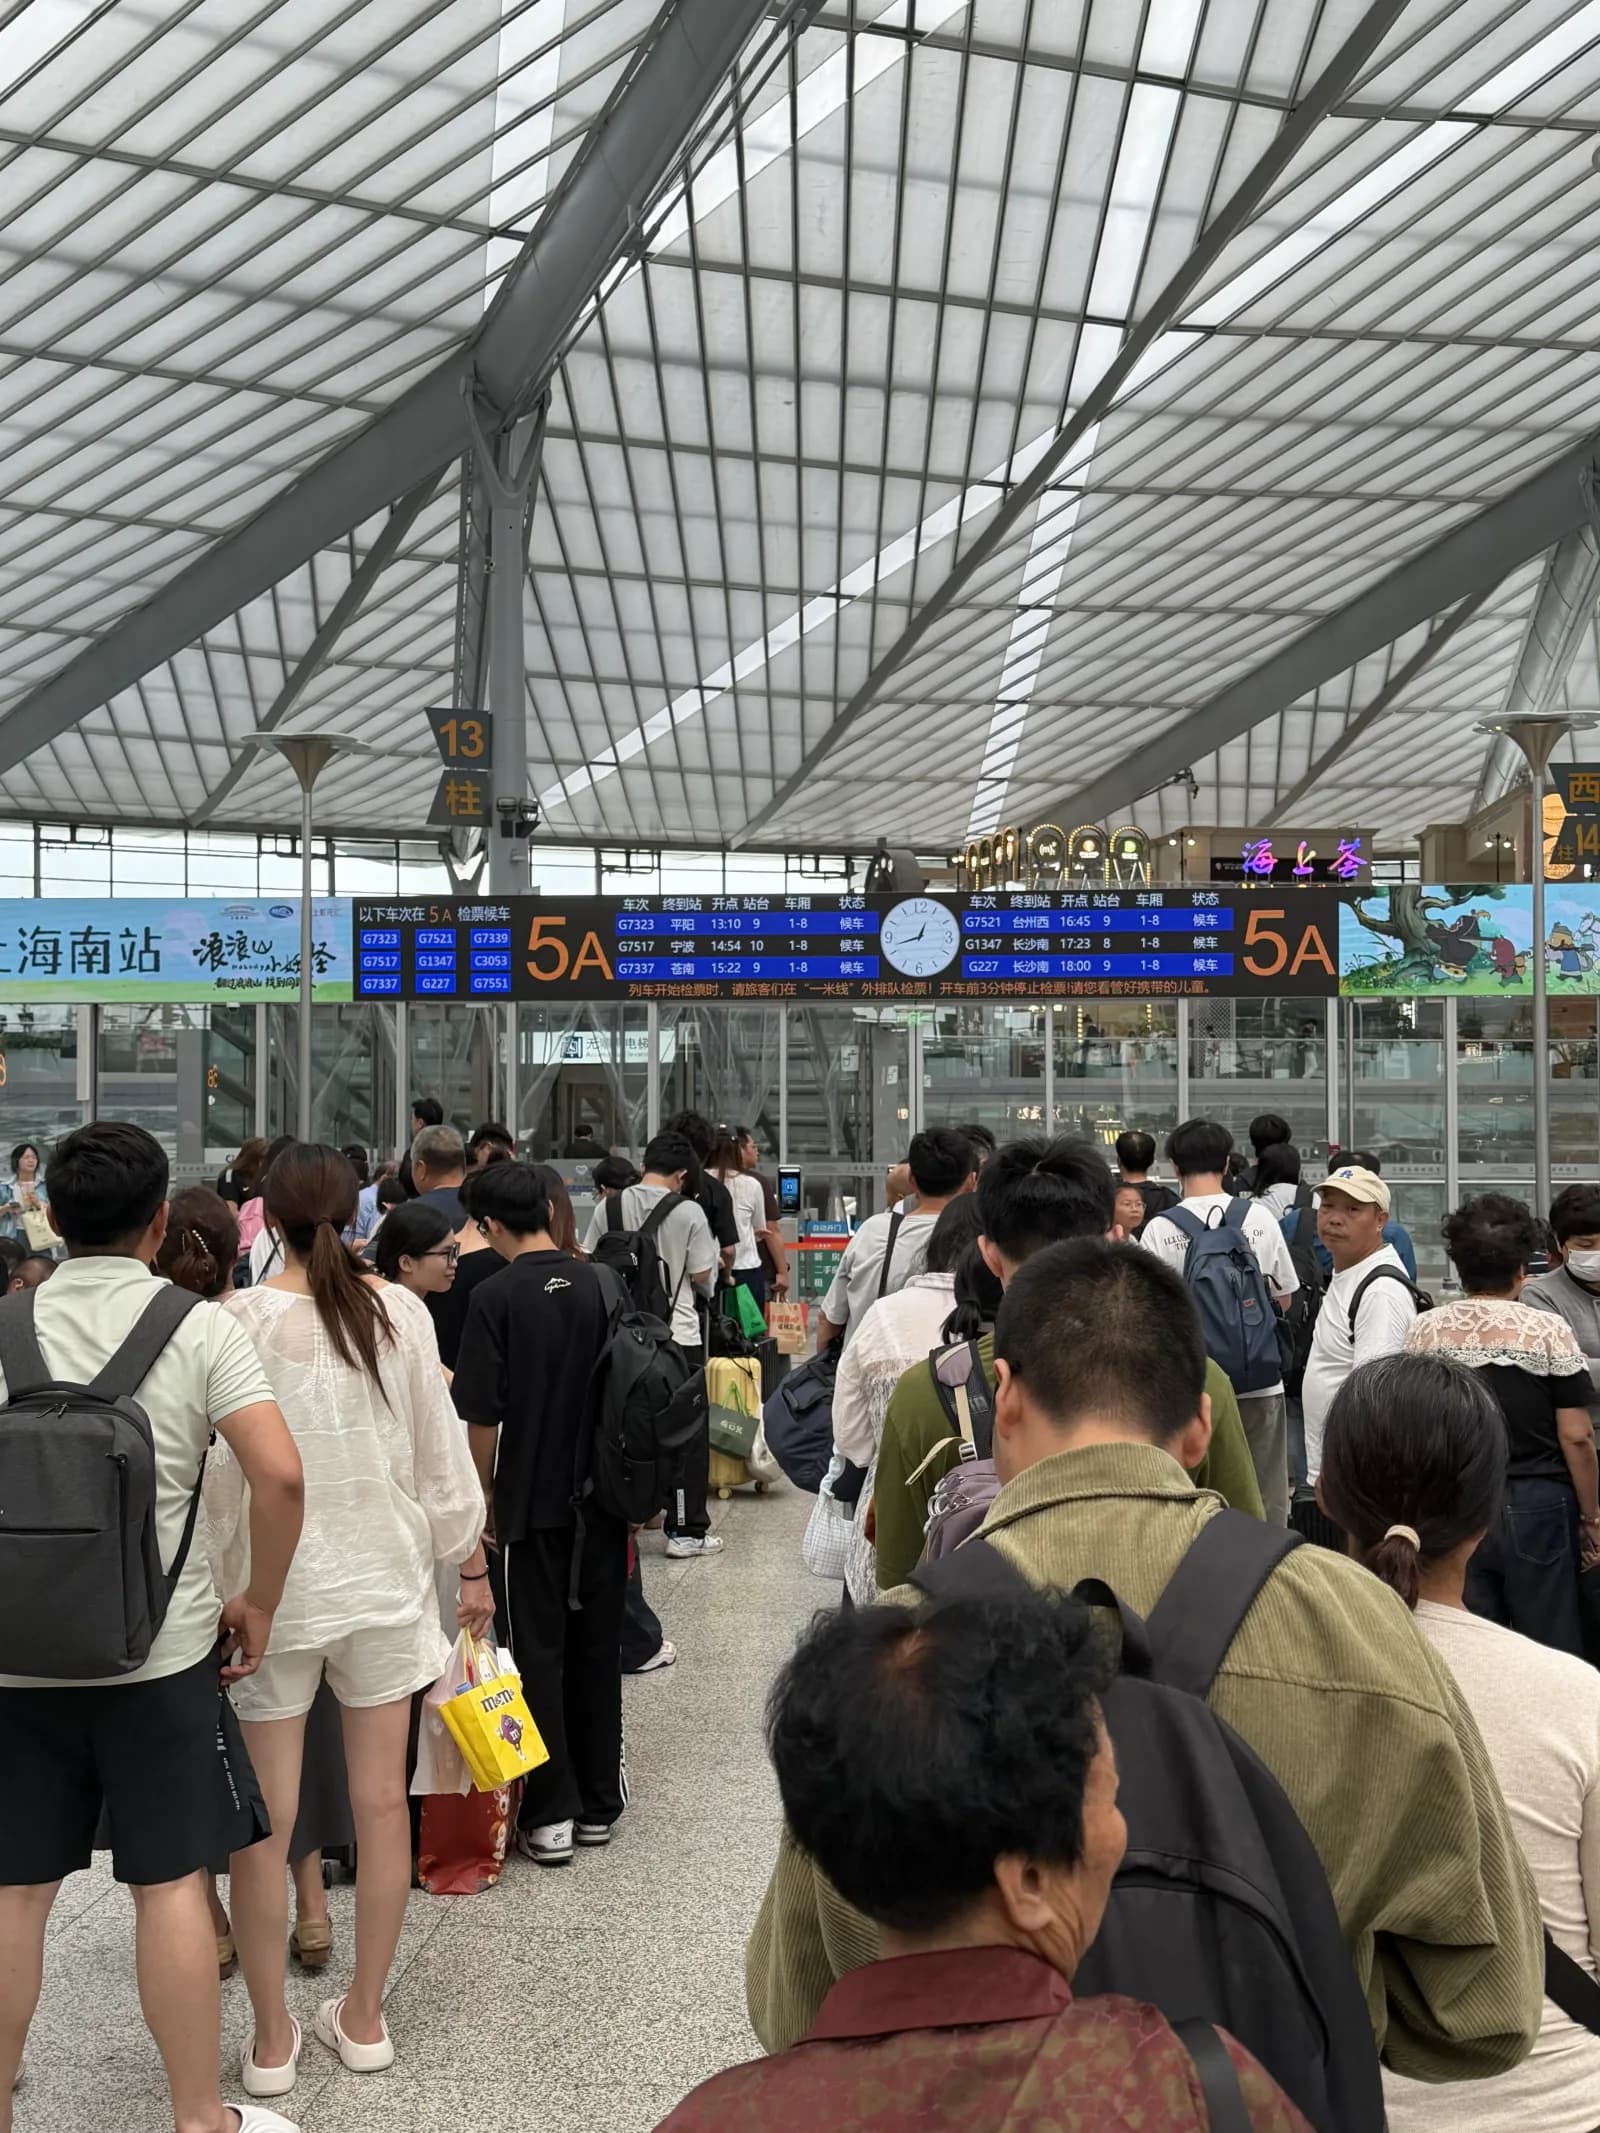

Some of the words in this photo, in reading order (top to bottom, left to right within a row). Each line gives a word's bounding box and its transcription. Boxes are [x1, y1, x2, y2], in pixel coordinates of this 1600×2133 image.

[439, 719, 485, 758] 13
[1567, 772, 1600, 804] 西
[446, 780, 481, 816] 柱
[1575, 822, 1600, 857] 14
[623, 897, 649, 912] 车次
[662, 896, 703, 911] 终到站
[711, 896, 739, 911] 开点
[743, 896, 770, 911] 站台
[784, 896, 811, 910] 车厢
[838, 895, 865, 910] 状态
[912, 901, 930, 914] 12
[969, 894, 997, 909] 车次
[1010, 894, 1051, 909] 终到站
[1060, 893, 1089, 908] 开点
[1092, 892, 1121, 908] 站台
[1135, 892, 1163, 907] 车厢
[1191, 891, 1220, 906] 状态
[359, 906, 426, 923] 以下车次在
[457, 905, 511, 922] 检票候车
[964, 916, 1001, 928] G7521
[1012, 915, 1049, 929] 台州西
[1060, 915, 1091, 927] 16:45
[1103, 915, 1111, 927] 9
[1140, 914, 1160, 926] 1-8
[1192, 913, 1218, 927] 候车
[618, 919, 655, 930] G7323
[670, 918, 695, 931] 平阳
[711, 918, 742, 930] 13:10
[752, 918, 761, 929] 9
[789, 917, 808, 929] 1-8
[839, 917, 864, 930] 候车
[363, 933, 398, 945] G7323
[418, 933, 453, 944] G7521
[473, 932, 509, 944] G7339
[884, 931, 893, 944] 9
[944, 931, 953, 944] 3
[964, 938, 1002, 950] G1347
[1012, 937, 1049, 951] 长沙南
[1060, 937, 1091, 949] 17:23
[1103, 937, 1111, 949] 8
[1140, 936, 1160, 949] 1-8
[1192, 935, 1218, 949] 候车
[1243, 909, 1335, 977] 5A
[0, 925, 163, 975] 海南站
[527, 916, 613, 981] 5A
[618, 940, 655, 953] G7517
[670, 940, 695, 954] 宁波
[711, 940, 741, 952] 14:54
[750, 940, 764, 951] 10
[789, 939, 808, 951] 1-8
[839, 939, 865, 952] 候车
[363, 956, 398, 967] G7517
[418, 955, 453, 967] G1347
[474, 955, 508, 967] C3053
[618, 962, 655, 975] G7337
[670, 962, 695, 975] 苍南
[711, 962, 741, 974] 15:22
[752, 961, 761, 973] 9
[789, 961, 808, 973] 1-8
[839, 961, 865, 974] 候车
[914, 961, 924, 975] 6
[968, 960, 999, 972] G227
[1013, 960, 1049, 974] 长沙南
[1060, 960, 1091, 972] 18:00
[1103, 959, 1111, 972] 9
[1140, 959, 1160, 971] 1-8
[1193, 958, 1218, 972] 候车
[363, 978, 398, 990] G7337
[422, 978, 450, 989] G227
[473, 977, 508, 989] G7551
